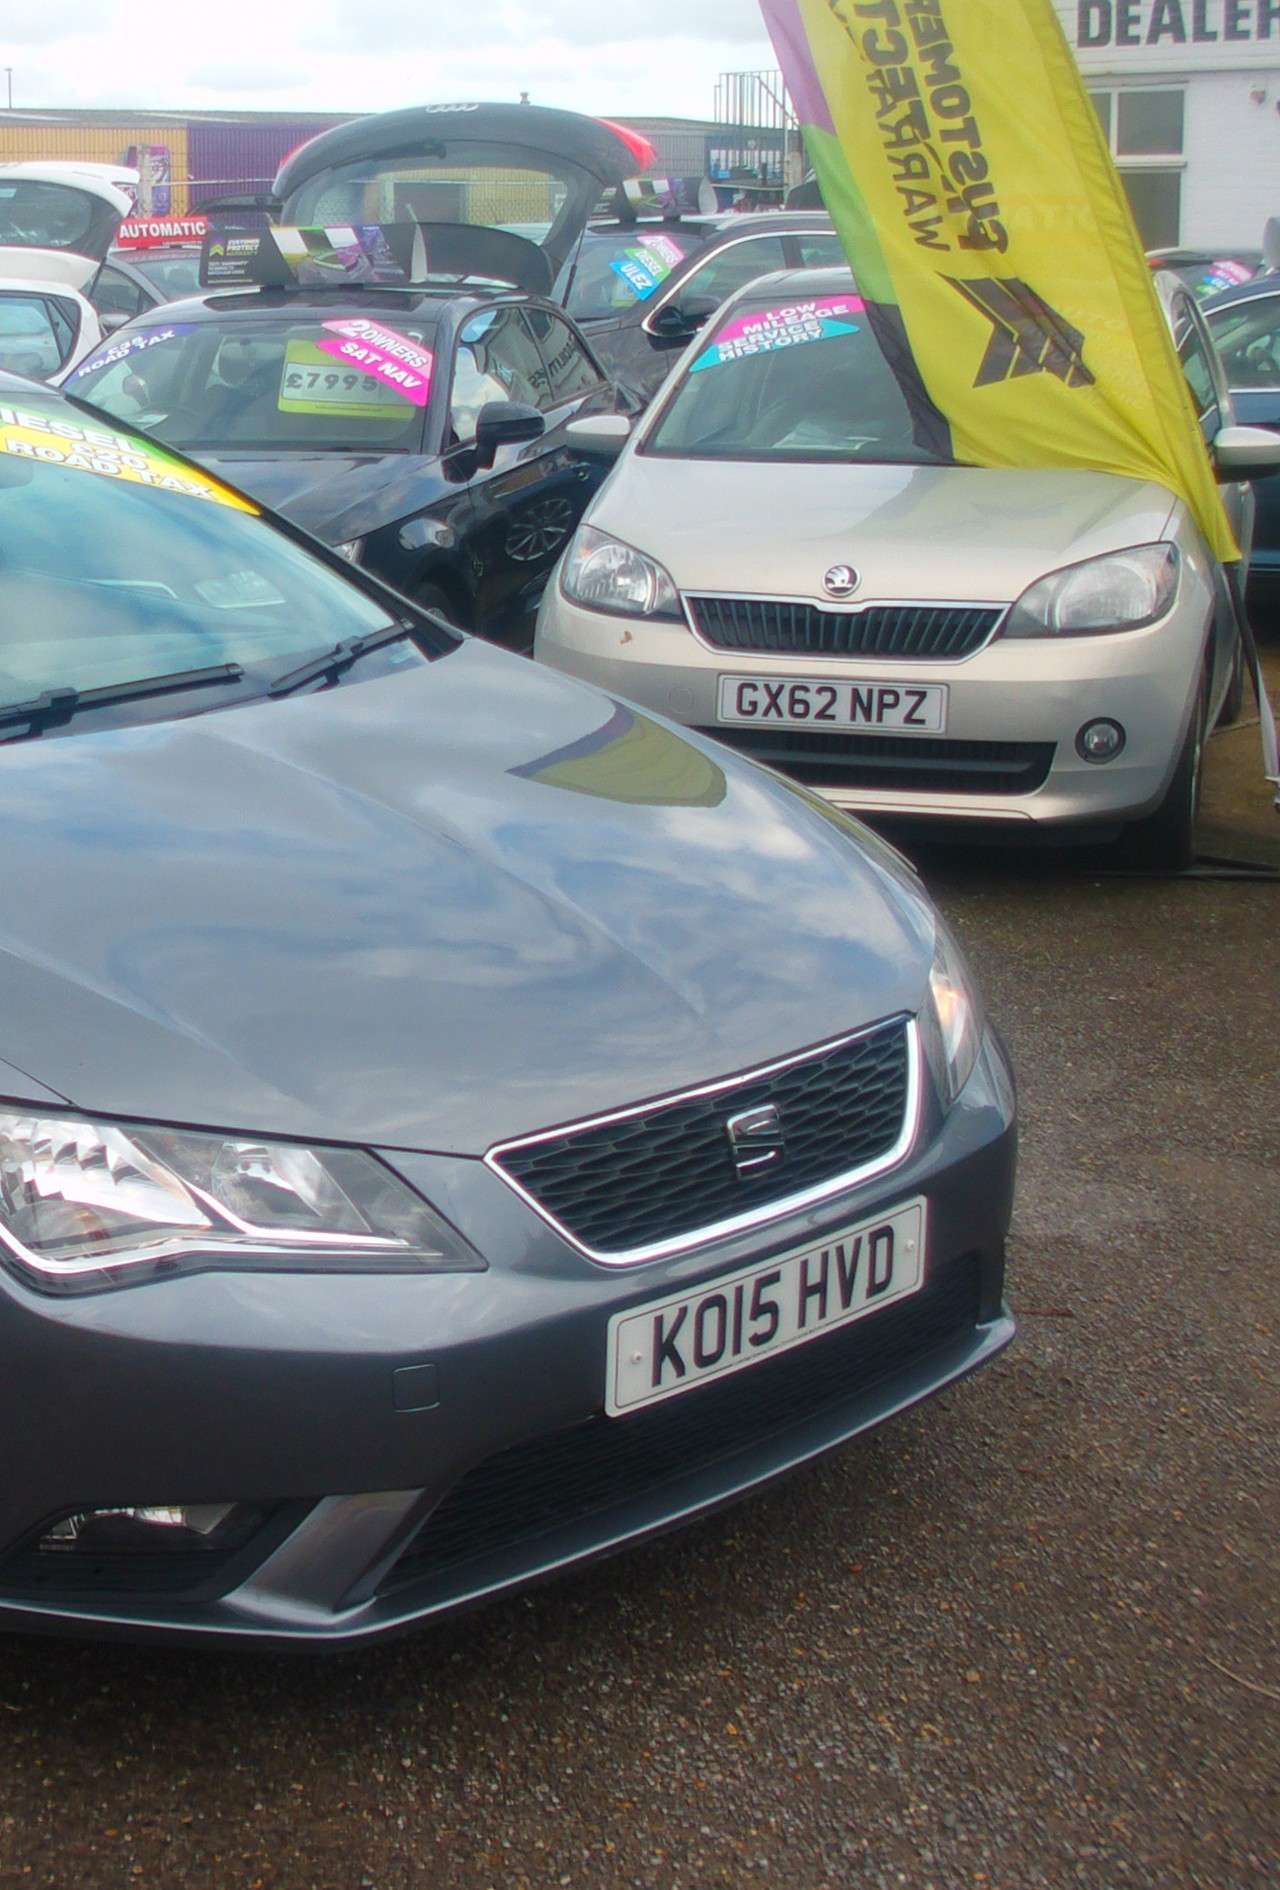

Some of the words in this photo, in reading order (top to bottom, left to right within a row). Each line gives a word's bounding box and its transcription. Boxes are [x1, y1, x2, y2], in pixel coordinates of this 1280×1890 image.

[120, 222, 207, 239] AUTOMATIC
[620, 263, 653, 290] ULEZ
[742, 305, 849, 335] MILEAGE
[766, 303, 816, 321] LOW
[339, 319, 371, 338] 2
[361, 329, 429, 368] OWNERS
[718, 319, 820, 350] SERVICE
[720, 329, 822, 361] HISTORY
[340, 342, 383, 365] SAT
[378, 361, 423, 388] NAV
[285, 372, 379, 392] £7995
[4, 438, 120, 476] ROAD
[137, 468, 214, 498] TAX
[736, 682, 837, 719] GX62
[850, 687, 928, 725] NPZ
[797, 1225, 895, 1329] HVD
